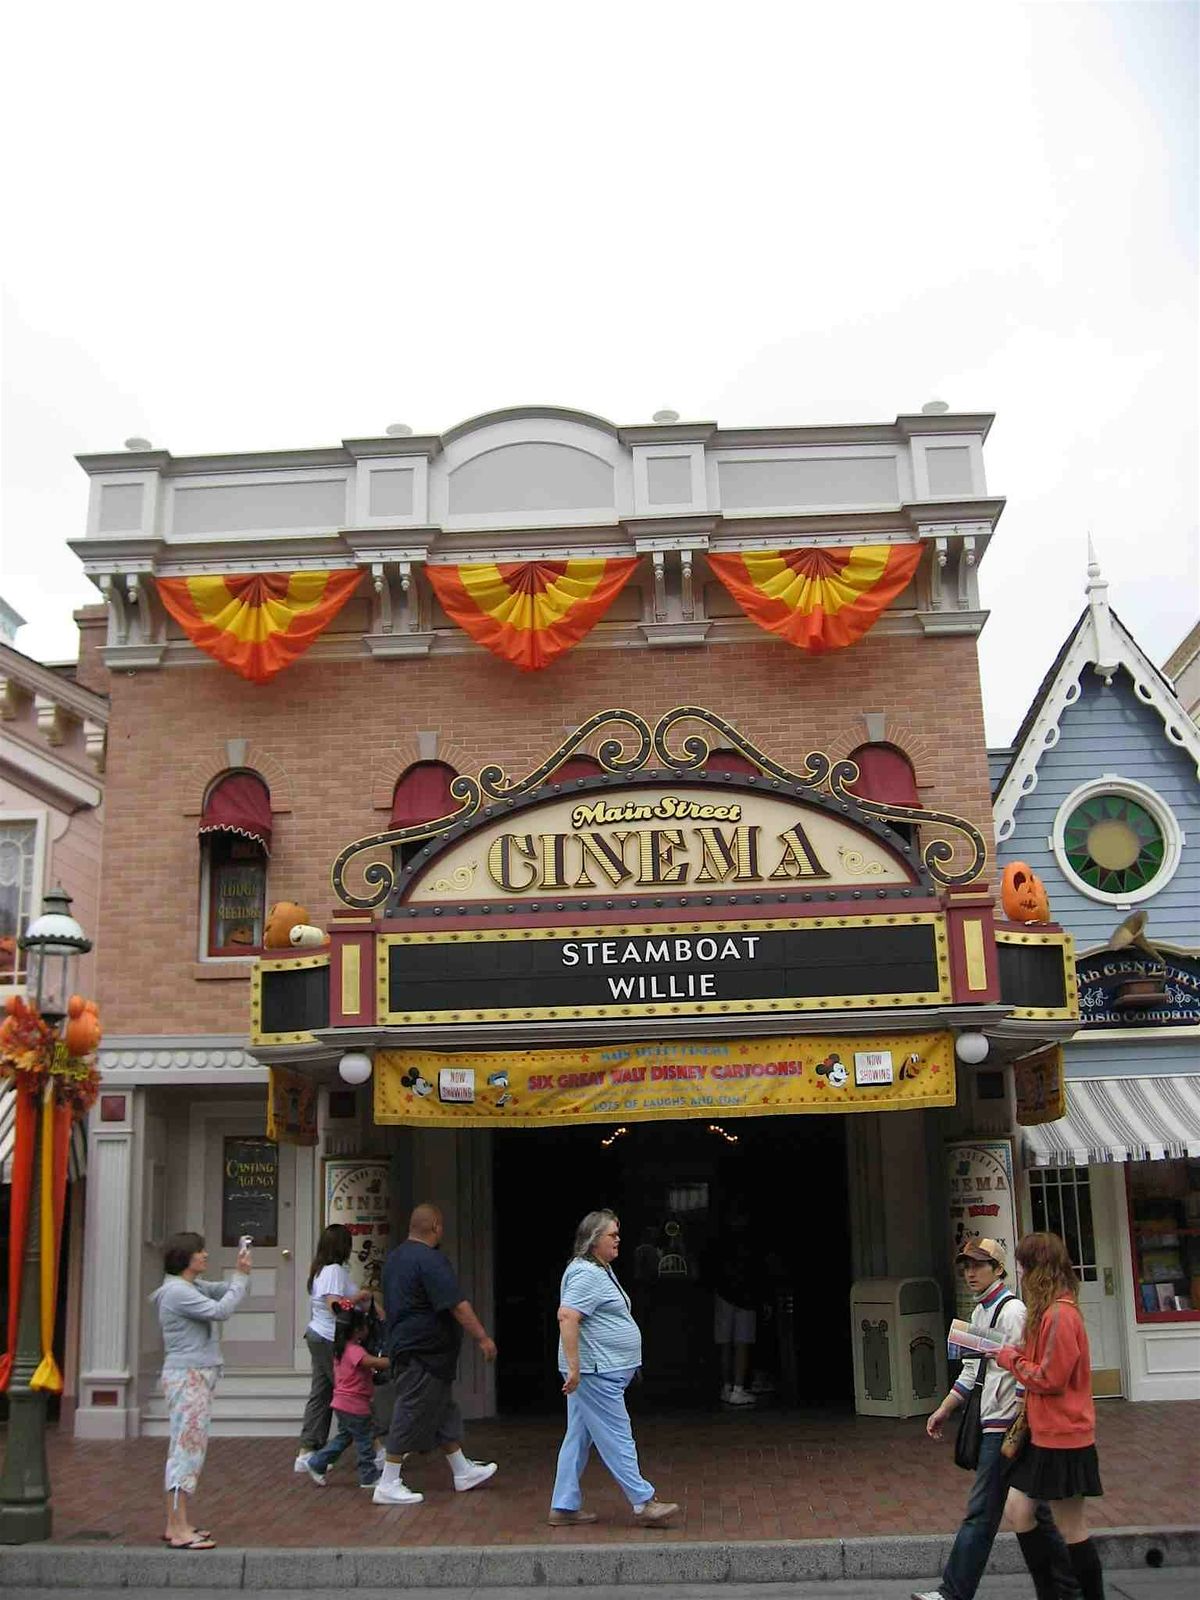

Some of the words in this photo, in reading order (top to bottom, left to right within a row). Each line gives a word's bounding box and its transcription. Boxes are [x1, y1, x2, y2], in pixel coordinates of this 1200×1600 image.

[571, 801, 653, 829] Main
[658, 796, 742, 823] Street
[487, 822, 832, 892] CINEMA
[562, 936, 760, 966] STEAMBOAT
[607, 974, 717, 999] WILLIE
[1123, 1010, 1200, 1023] Company
[862, 1055, 883, 1065] NOW
[450, 1072, 468, 1083] NOW
[527, 1074, 554, 1091] SIX
[557, 1071, 605, 1089] GREAT
[608, 1066, 647, 1085] WALT
[650, 1064, 707, 1082] DISNEY
[710, 1060, 803, 1080] CARTOONS!
[860, 1068, 891, 1081] SHOWING
[441, 1087, 472, 1098] SHOWING
[624, 1099, 639, 1109] OF
[643, 1096, 685, 1108] LAUGHS
[690, 1095, 713, 1105] AND
